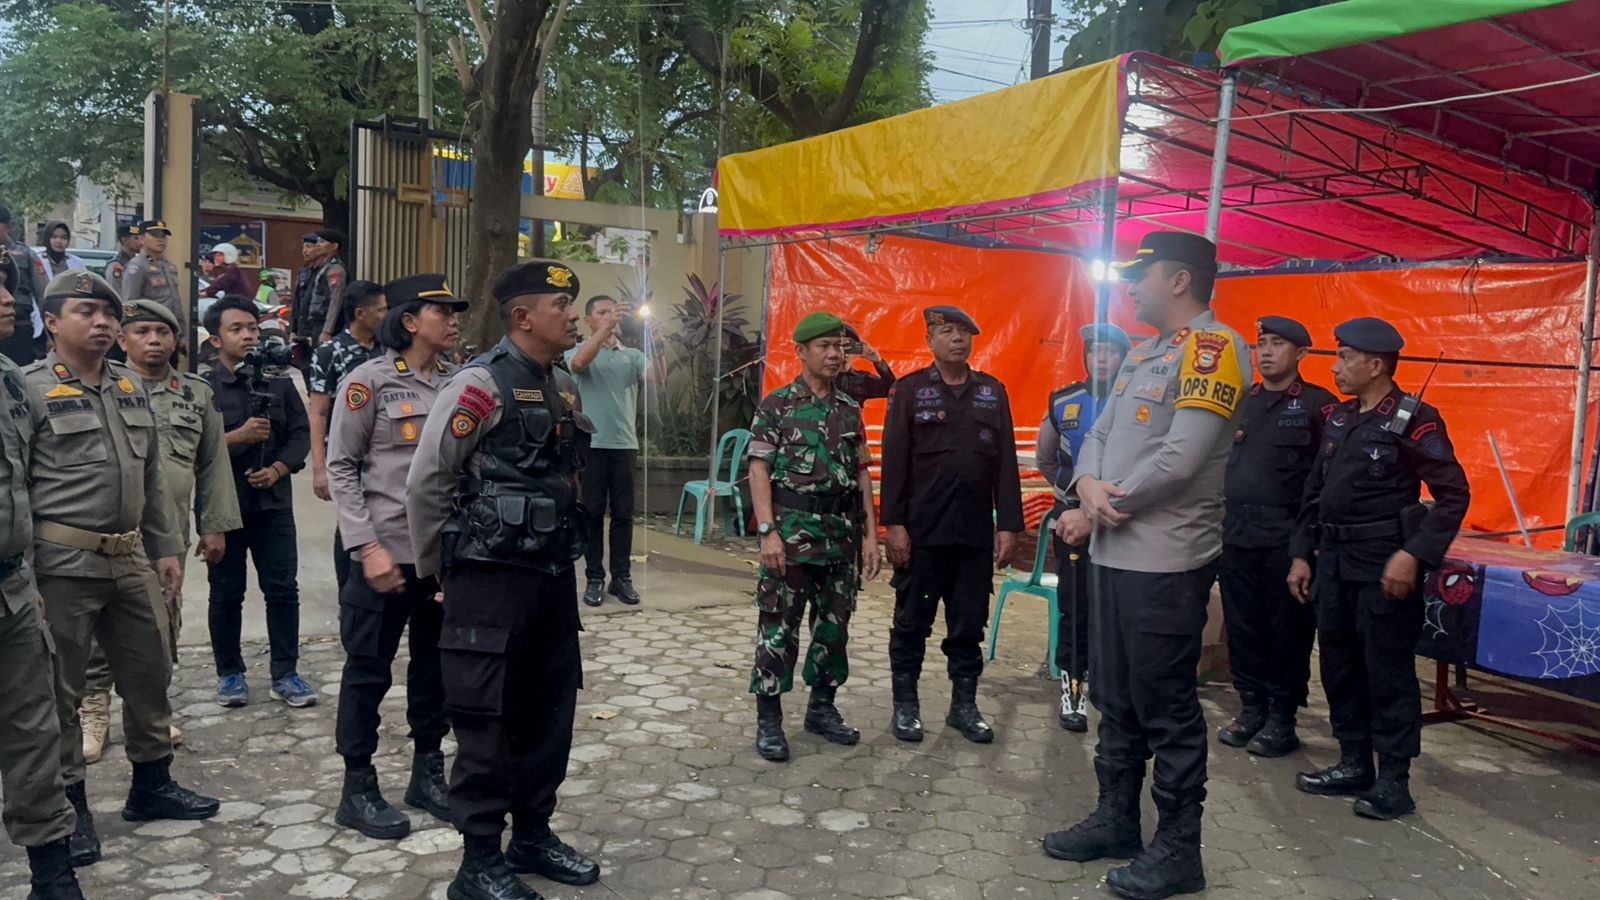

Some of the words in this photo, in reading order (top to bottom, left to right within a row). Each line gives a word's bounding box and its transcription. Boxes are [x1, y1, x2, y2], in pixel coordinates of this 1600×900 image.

[1183, 377, 1208, 396] OPS
[1212, 381, 1236, 406] RES
[383, 391, 405, 403] DAYU
[116, 397, 136, 408] POL
[171, 401, 189, 410] POL
[917, 400, 943, 408] ARIF
[1277, 419, 1308, 427] POLRI
